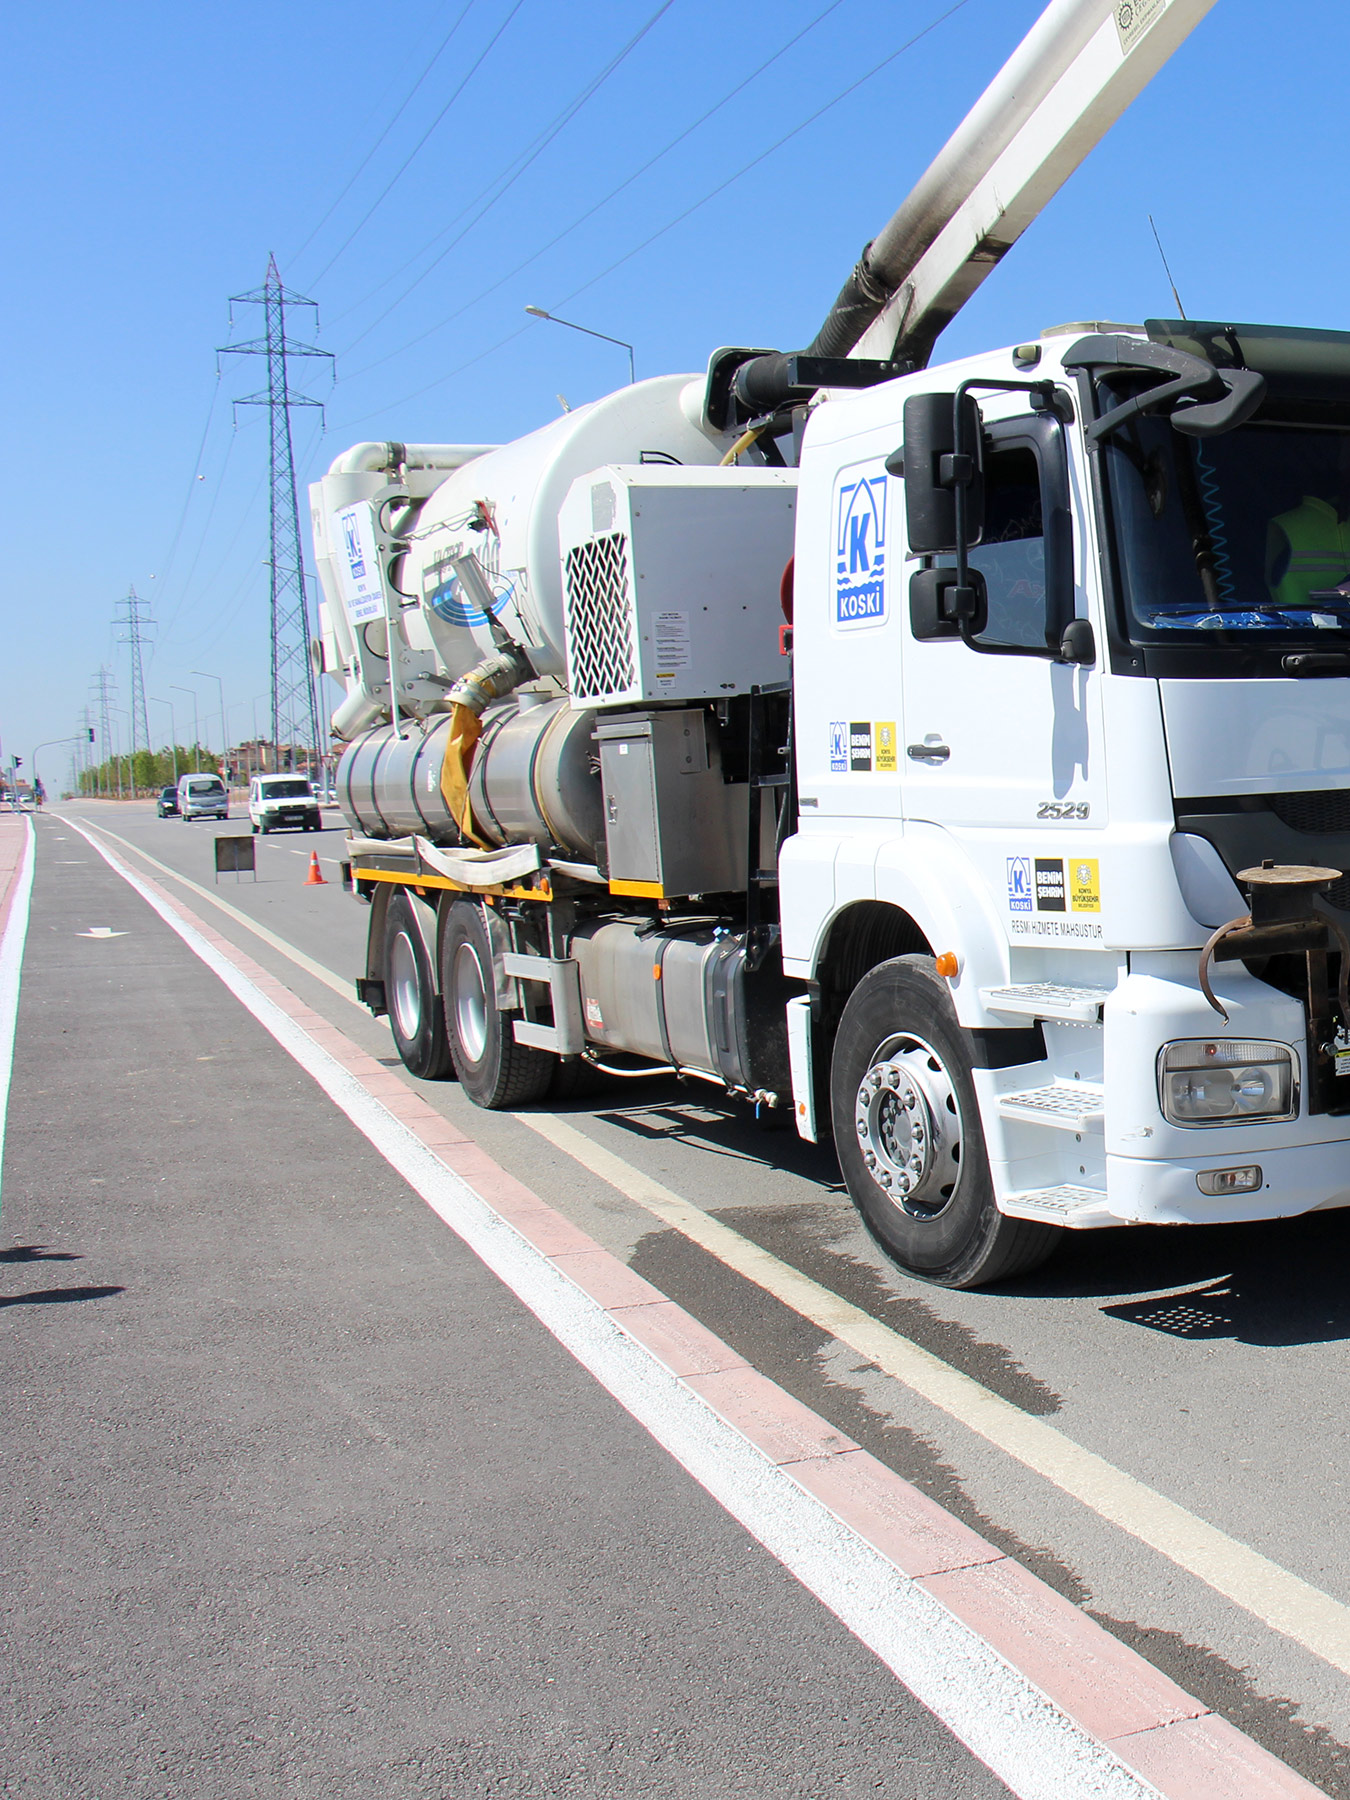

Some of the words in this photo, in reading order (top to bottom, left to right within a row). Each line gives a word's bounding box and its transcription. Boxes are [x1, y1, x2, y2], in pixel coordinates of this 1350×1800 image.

[850, 512, 871, 574] K
[840, 587, 880, 617] KOSKİ
[834, 734, 842, 755] K
[851, 735, 870, 746] BENİM
[851, 748, 870, 760] ŞEHRİM
[832, 761, 846, 771] KOSKİ
[1036, 802, 1090, 819] 2529
[1013, 870, 1024, 893] K
[1036, 871, 1062, 884] BENİM
[1037, 885, 1063, 898] ŞEHRİM
[1011, 899, 1031, 911] KOSKİ
[1060, 923, 1103, 939] MAHSUSTUR
